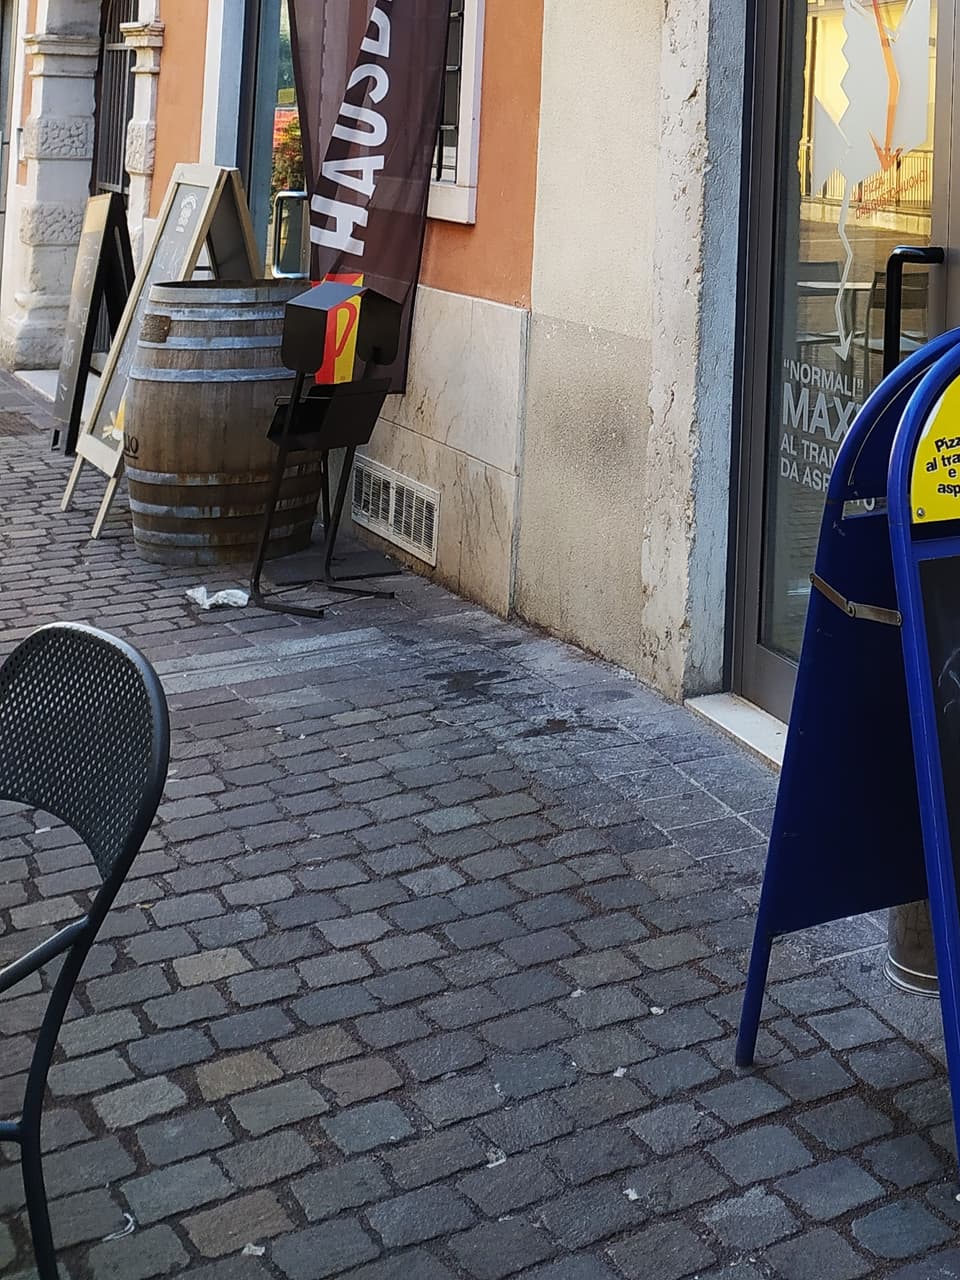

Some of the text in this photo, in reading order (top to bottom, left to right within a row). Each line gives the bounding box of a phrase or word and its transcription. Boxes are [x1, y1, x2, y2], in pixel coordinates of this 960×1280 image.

[780, 432, 798, 456] AL
[780, 457, 800, 483] DA
[926, 457, 938, 472] al
[948, 467, 957, 478] e
